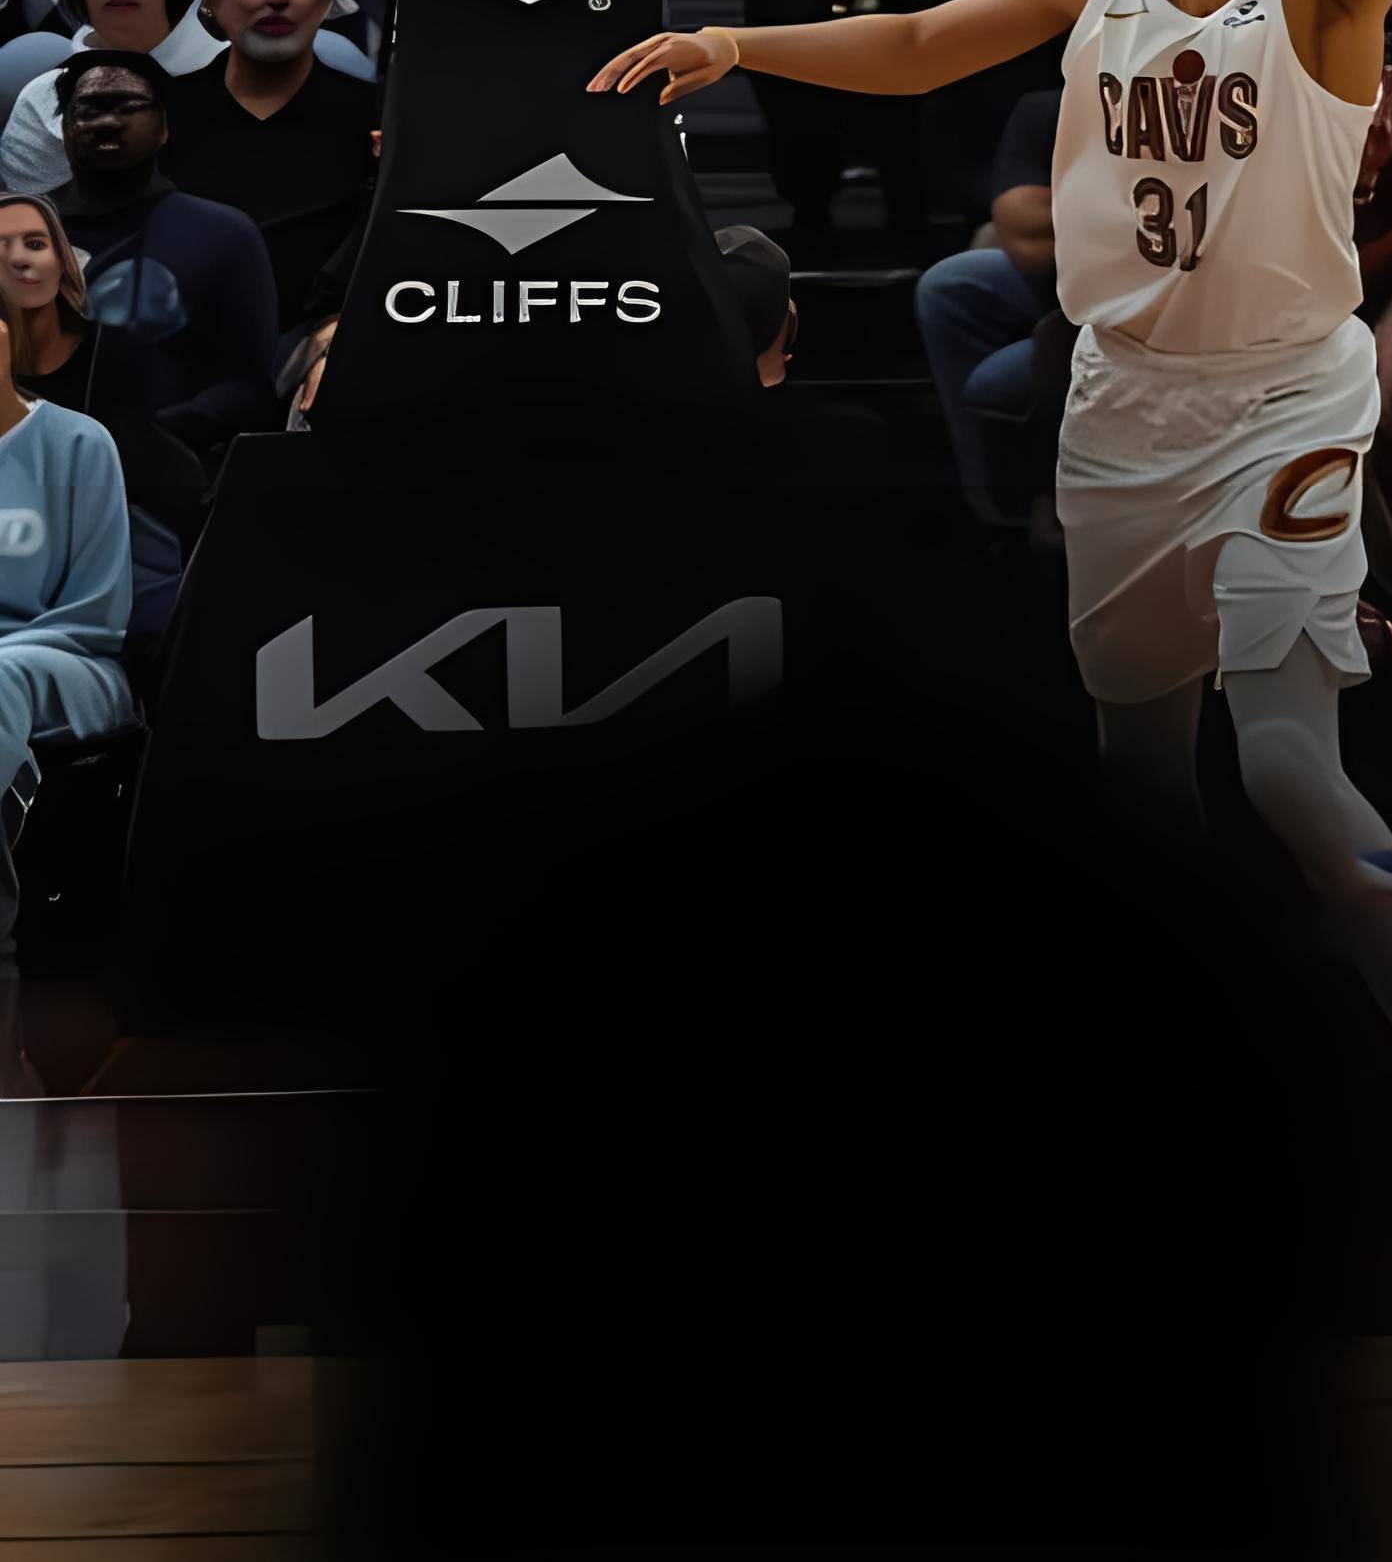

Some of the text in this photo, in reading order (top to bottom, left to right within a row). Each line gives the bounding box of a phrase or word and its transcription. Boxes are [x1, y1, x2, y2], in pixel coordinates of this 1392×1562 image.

[1098, 71, 1258, 163] CAVS
[1132, 176, 1209, 272] 31
[384, 280, 662, 324] CLIFFS
[256, 595, 784, 741] KIA
